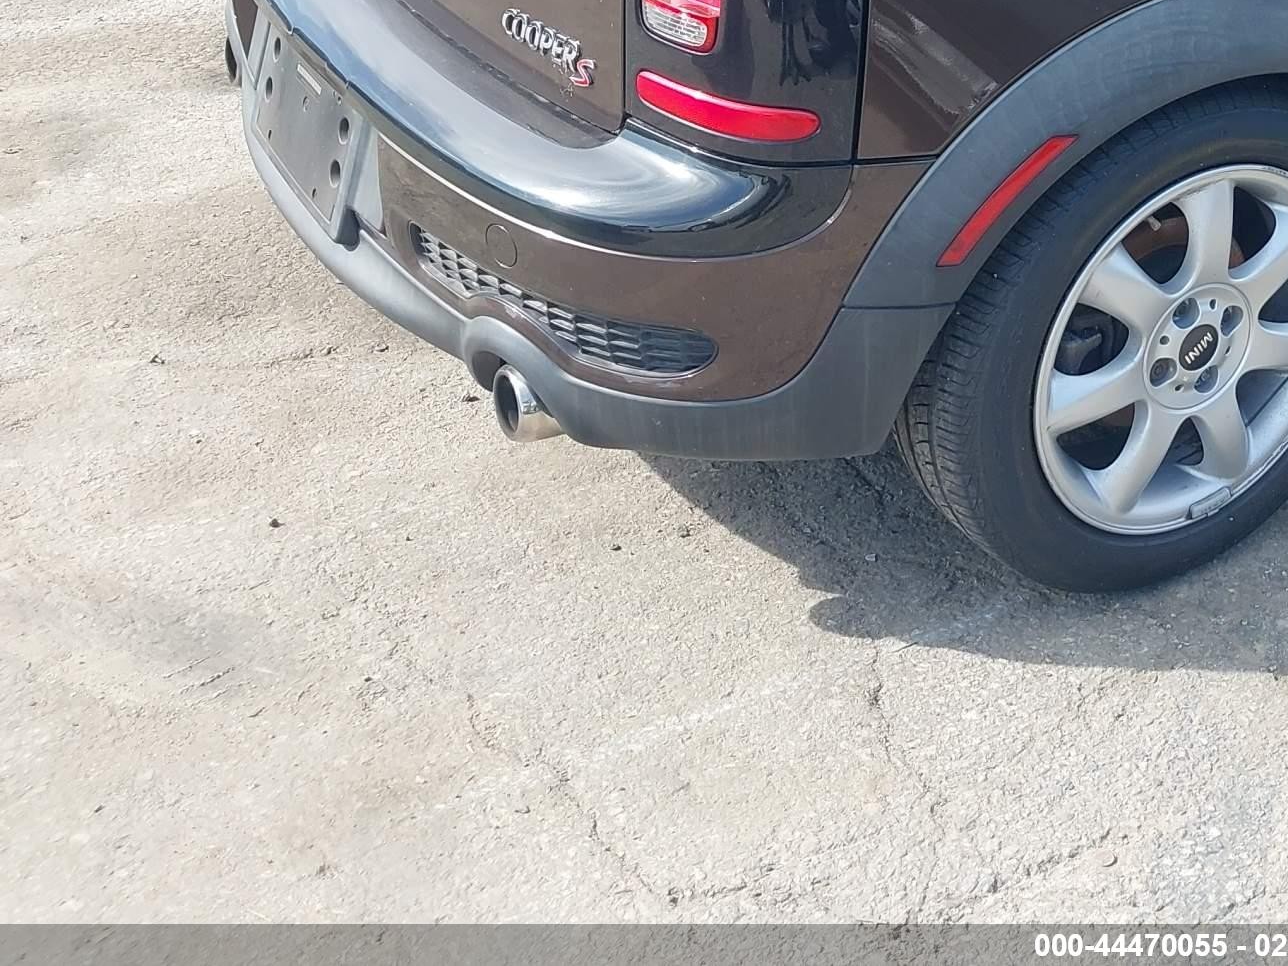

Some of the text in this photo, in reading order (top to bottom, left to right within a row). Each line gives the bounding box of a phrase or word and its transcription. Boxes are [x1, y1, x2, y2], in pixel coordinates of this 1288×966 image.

[502, 8, 597, 87] COOPER S
[1184, 332, 1214, 365] MINI
